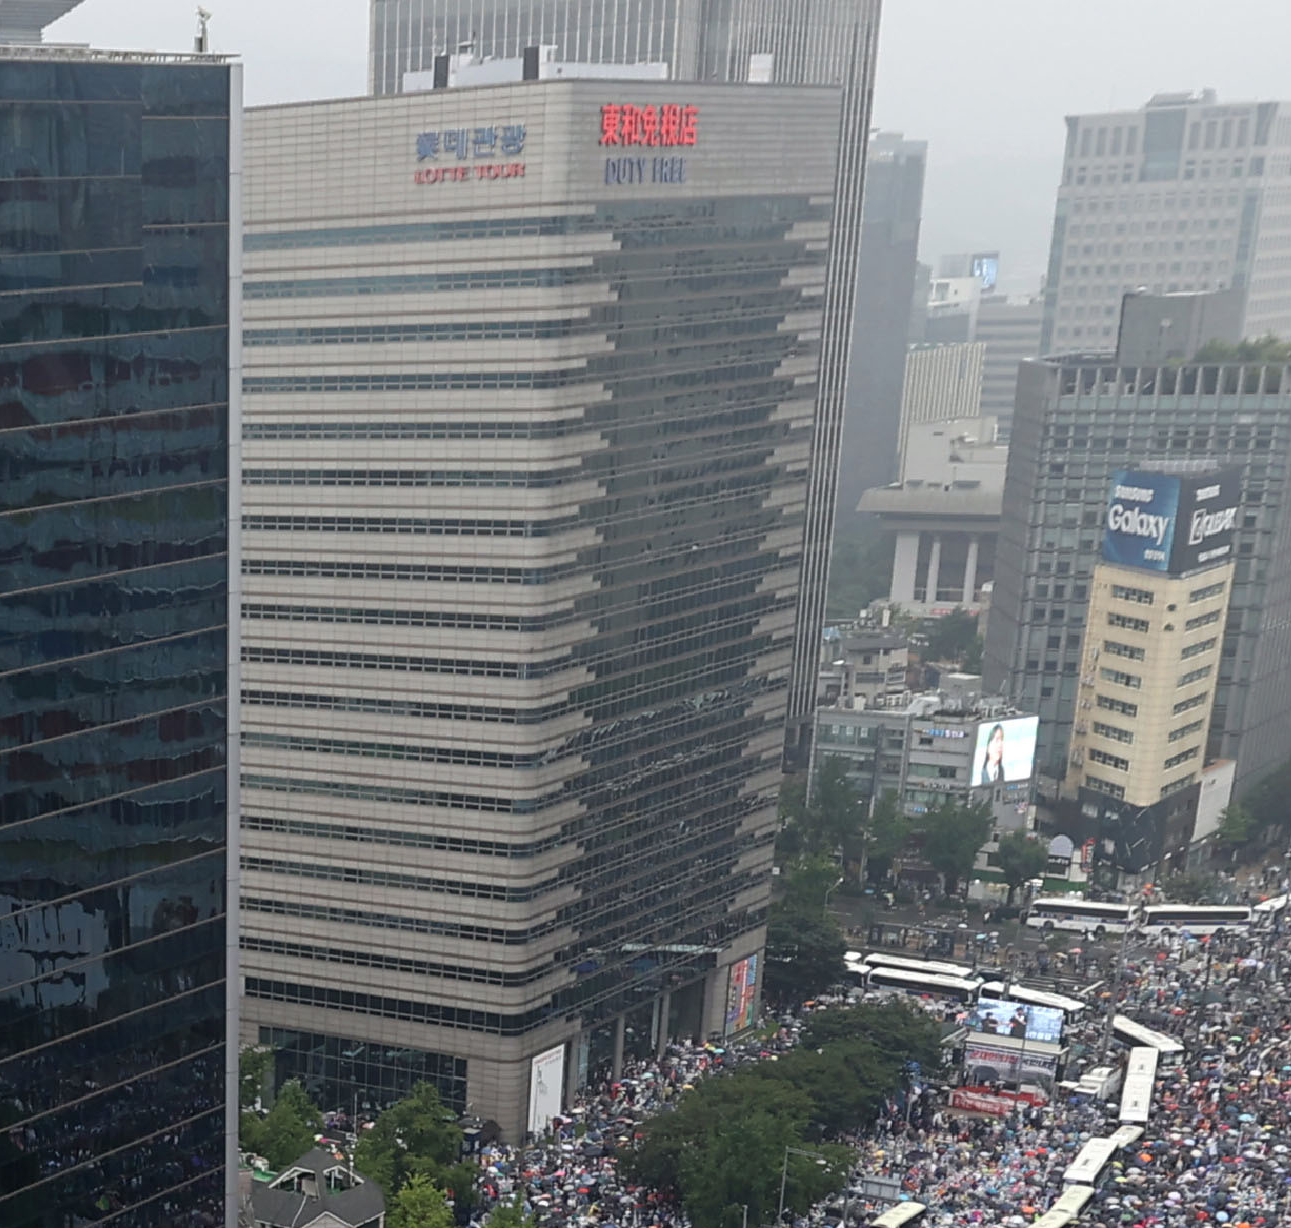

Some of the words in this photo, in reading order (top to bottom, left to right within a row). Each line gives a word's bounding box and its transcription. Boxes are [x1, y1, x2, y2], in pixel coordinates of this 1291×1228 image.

[414, 167, 470, 184] LOTTE
[474, 163, 526, 181] TOUR
[605, 157, 646, 185] DUTY
[1108, 503, 1169, 546] Galaxy
